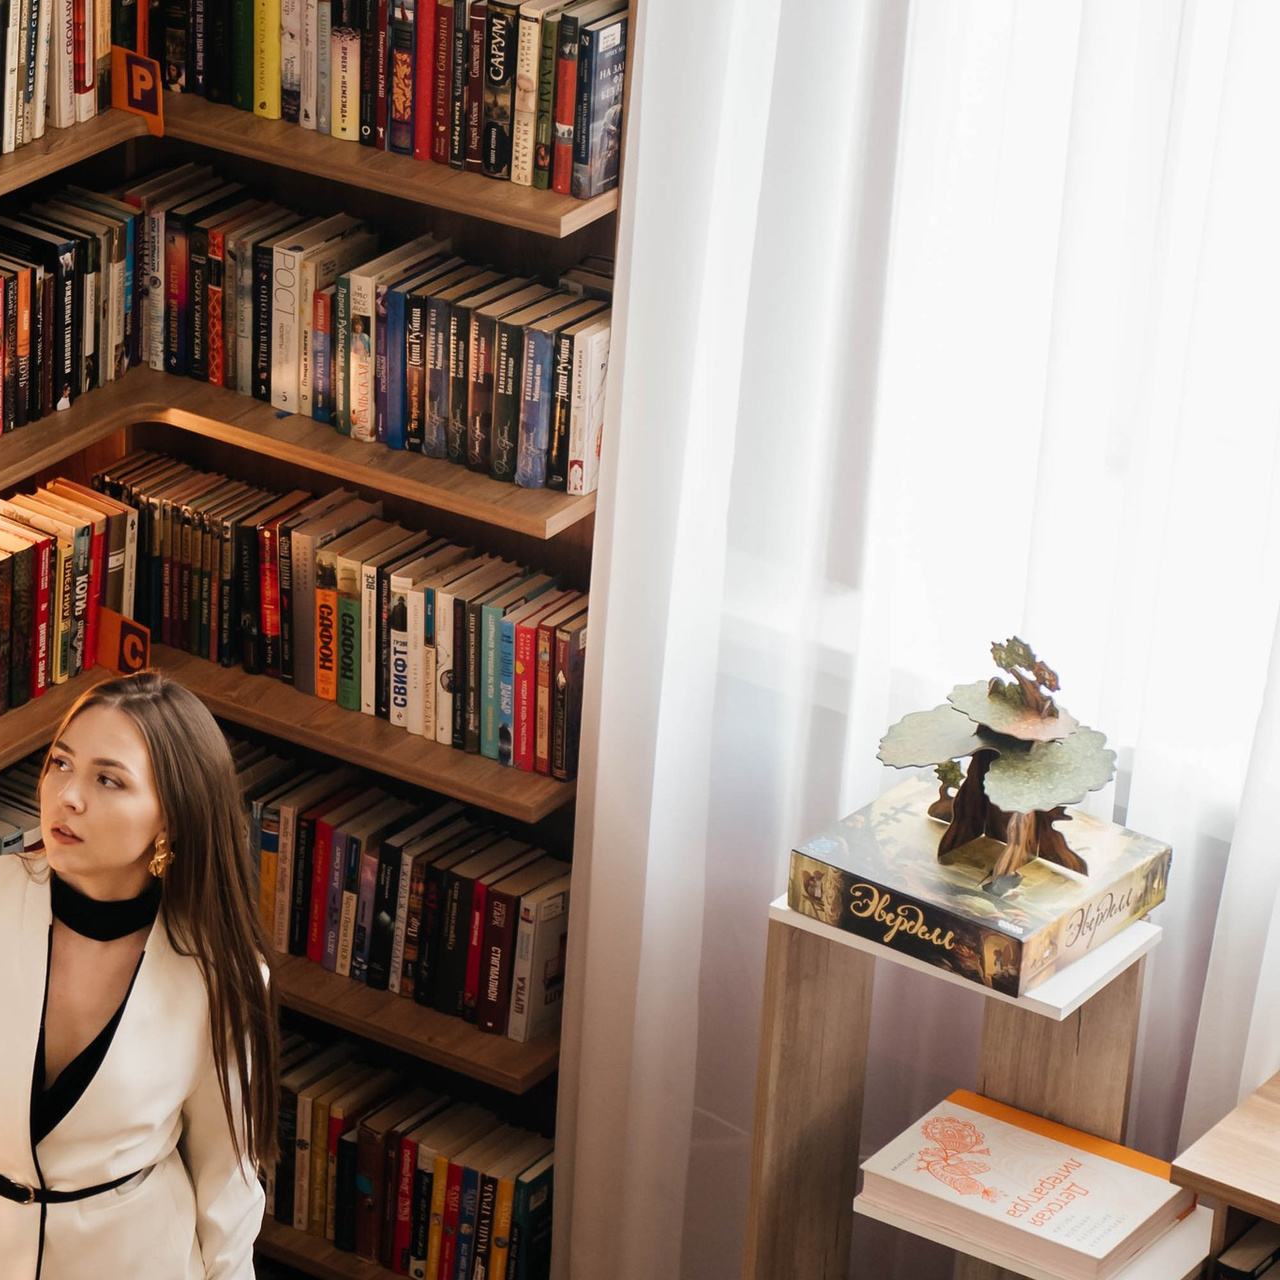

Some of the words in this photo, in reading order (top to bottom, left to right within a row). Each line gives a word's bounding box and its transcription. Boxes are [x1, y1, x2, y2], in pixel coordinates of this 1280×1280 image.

[259, 10, 267, 43] СЕСТРА
[258, 46, 266, 90] ЖЕМЧУГА
[275, 252, 296, 323] РОСТ
[338, 319, 346, 365] Рубальская
[412, 308, 422, 342] Рубина
[412, 343, 420, 365] Дина
[559, 340, 571, 373] Рубина
[19, 357, 27, 387] НОЧЬ
[556, 375, 568, 399] Дина
[358, 364, 368, 436] РУБАЛЬСКАЯ
[64, 560, 72, 589] РЭНД
[63, 592, 72, 615] АЙН
[39, 622, 47, 656] РЫЖИЙ
[320, 604, 332, 671] САФОН
[340, 613, 354, 681] САФОН
[38, 660, 46, 687] БОРИС
[393, 647, 408, 708] СВИФТ
[408, 918, 420, 936] Пир
[850, 883, 955, 950] Эверделл
[1066, 888, 1134, 948] Эверделл
[488, 947, 500, 1002] СТИГМАЛИОН
[515, 976, 526, 1014] ШУТКА
[450, 1184, 460, 1211] ТРАУБ
[482, 1184, 494, 1215] ТРАУБ
[1006, 1158, 1084, 1219] литература
[1030, 1180, 1090, 1228] Детская
[476, 1218, 490, 1252] МАША
